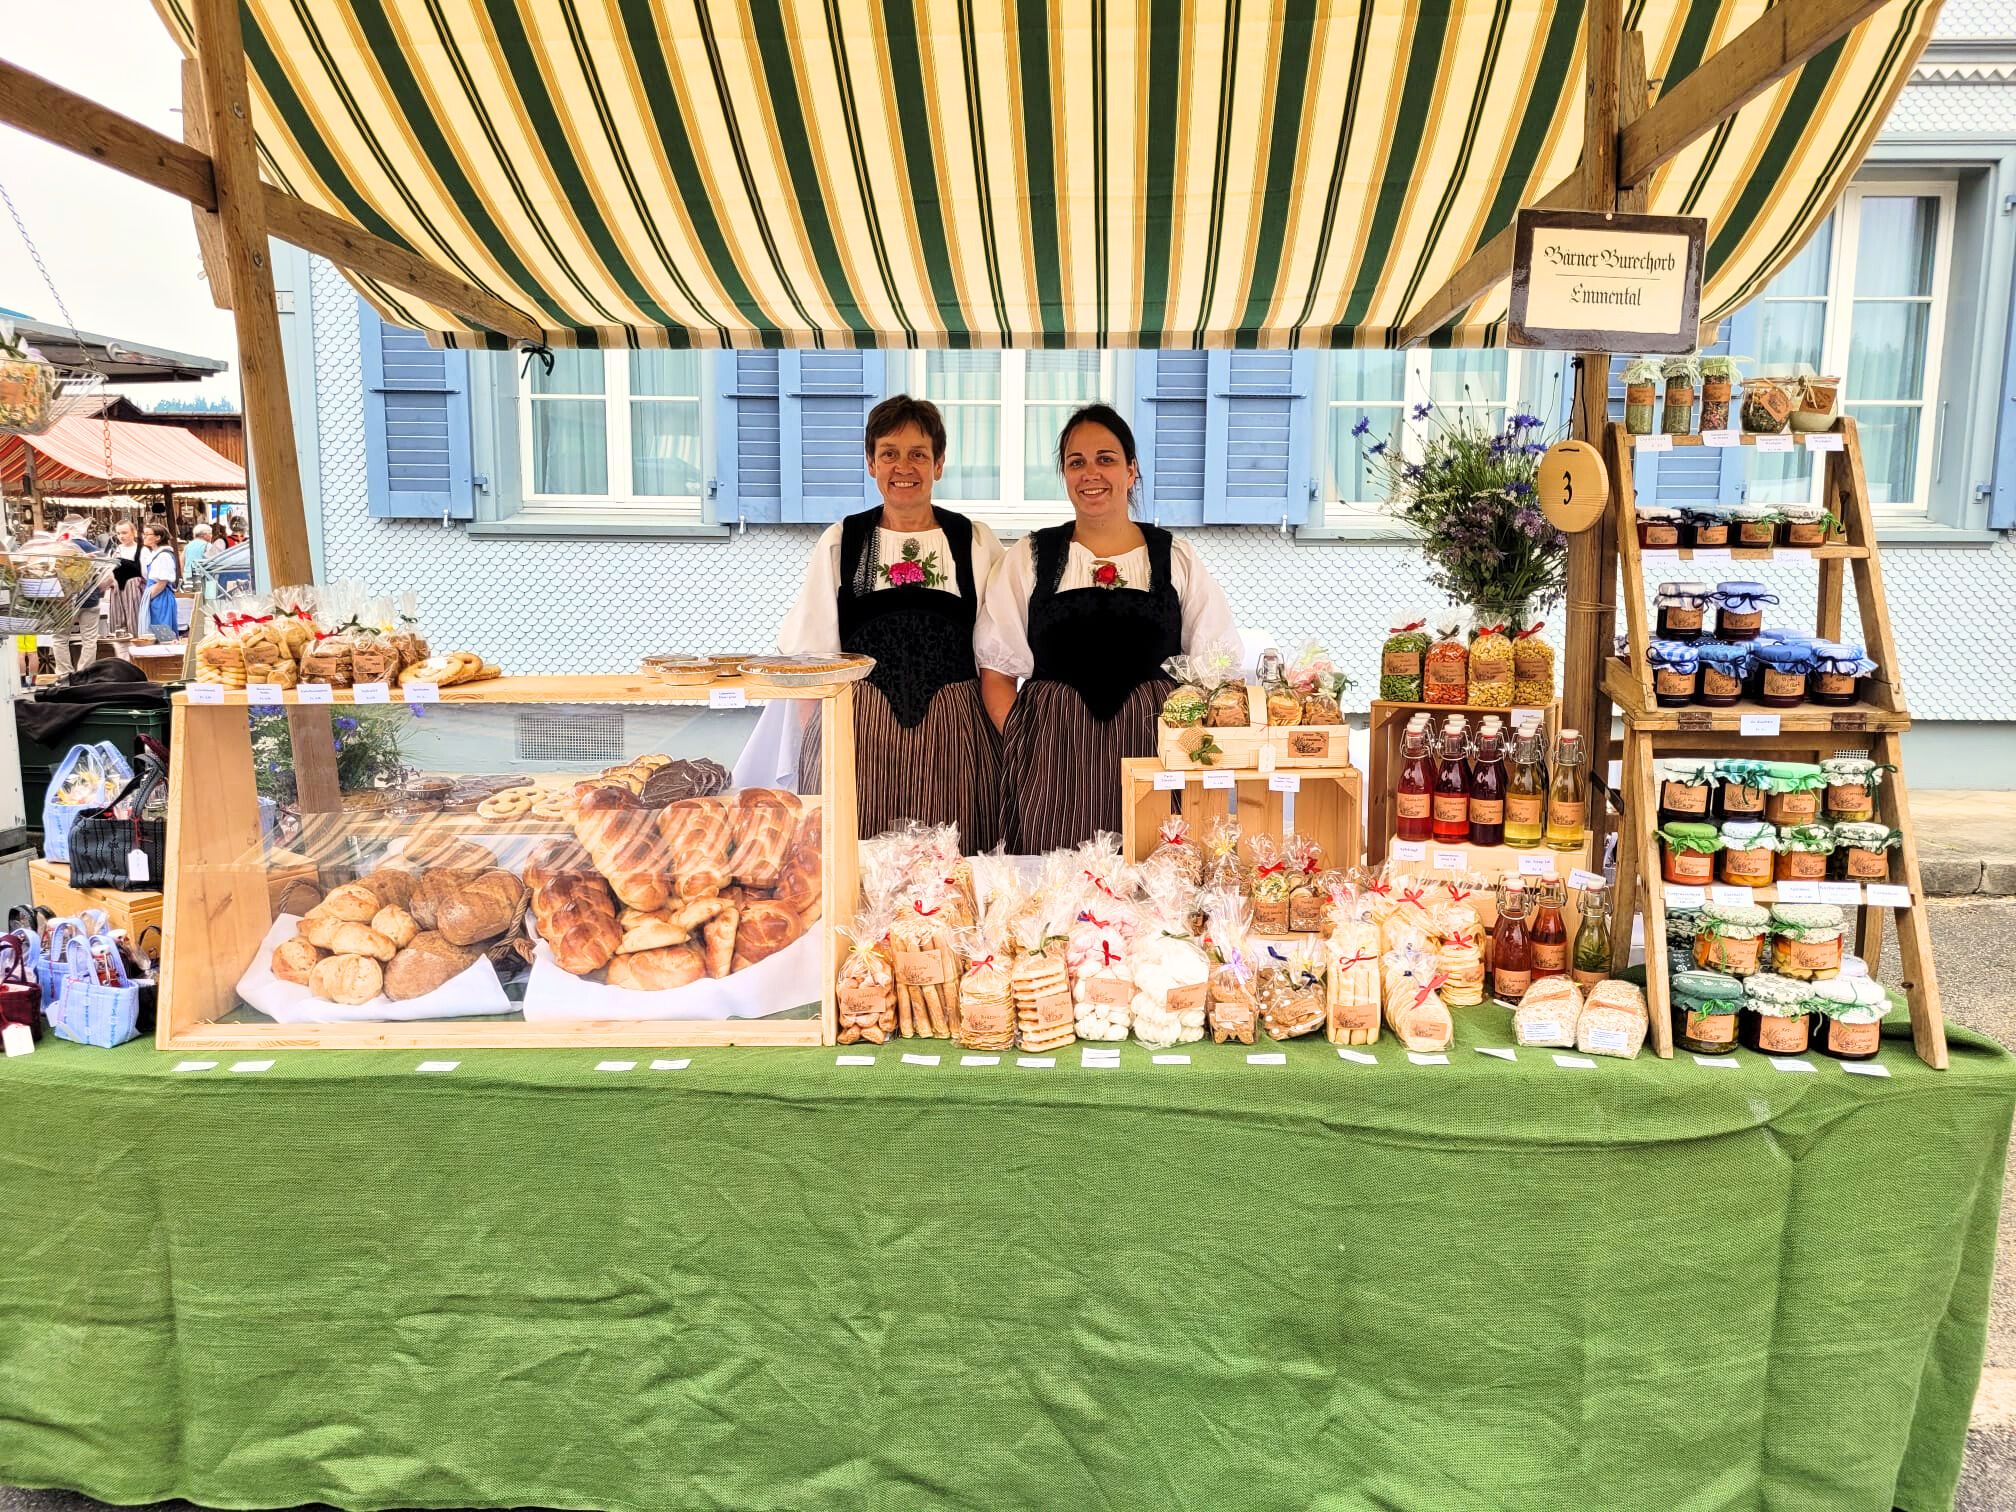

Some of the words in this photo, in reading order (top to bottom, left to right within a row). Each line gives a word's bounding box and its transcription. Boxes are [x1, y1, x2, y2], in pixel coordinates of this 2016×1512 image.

[1544, 245, 1599, 267] Bärner
[1600, 248, 1675, 274] Burechorb
[1569, 282, 1642, 306] Emmental
[1562, 470, 1573, 505] 3
